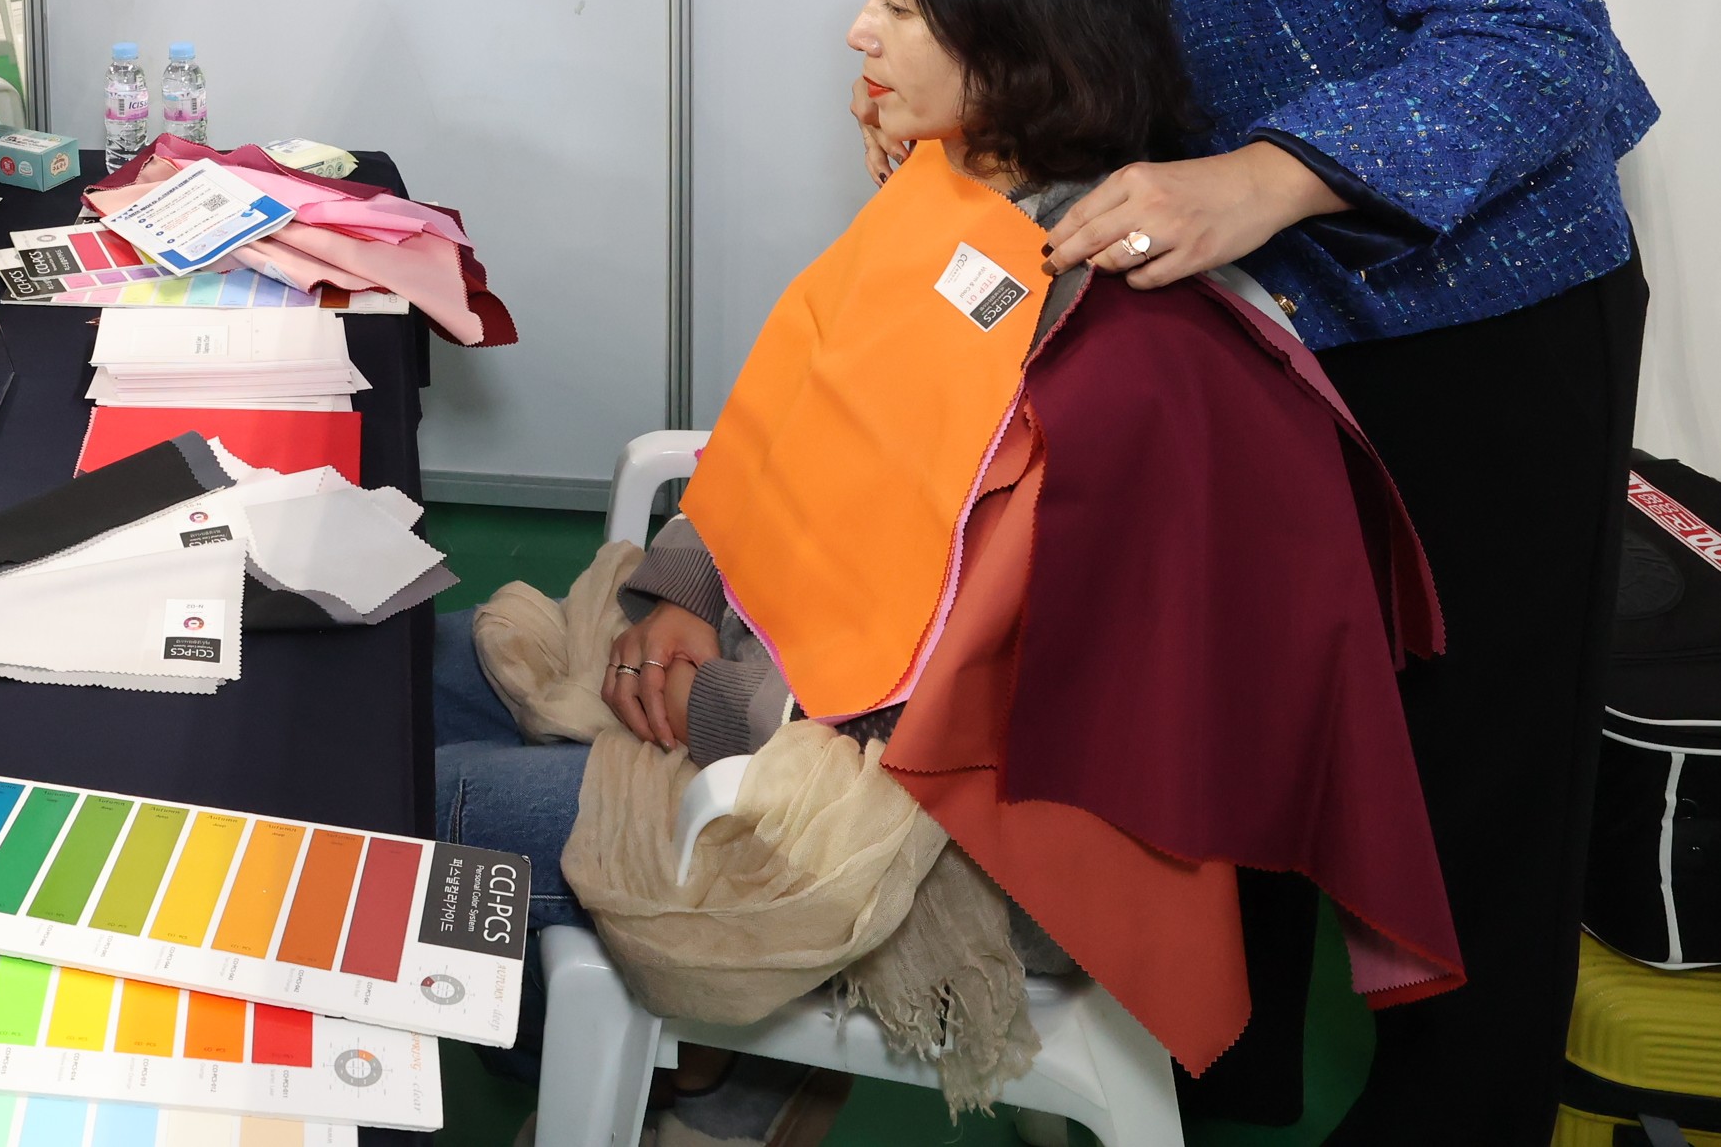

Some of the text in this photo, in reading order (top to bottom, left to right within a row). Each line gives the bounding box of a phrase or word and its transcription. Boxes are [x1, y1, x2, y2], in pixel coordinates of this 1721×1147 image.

[30, 249, 51, 276] CCI-PCS
[978, 273, 997, 295] STEP
[983, 289, 1018, 323] CCI-PCS
[169, 648, 215, 659] CCI-PCS
[439, 858, 463, 933] 퍼스널컬러가이드
[467, 864, 485, 932] Personal Color System
[483, 863, 518, 945] CCI-PCS
